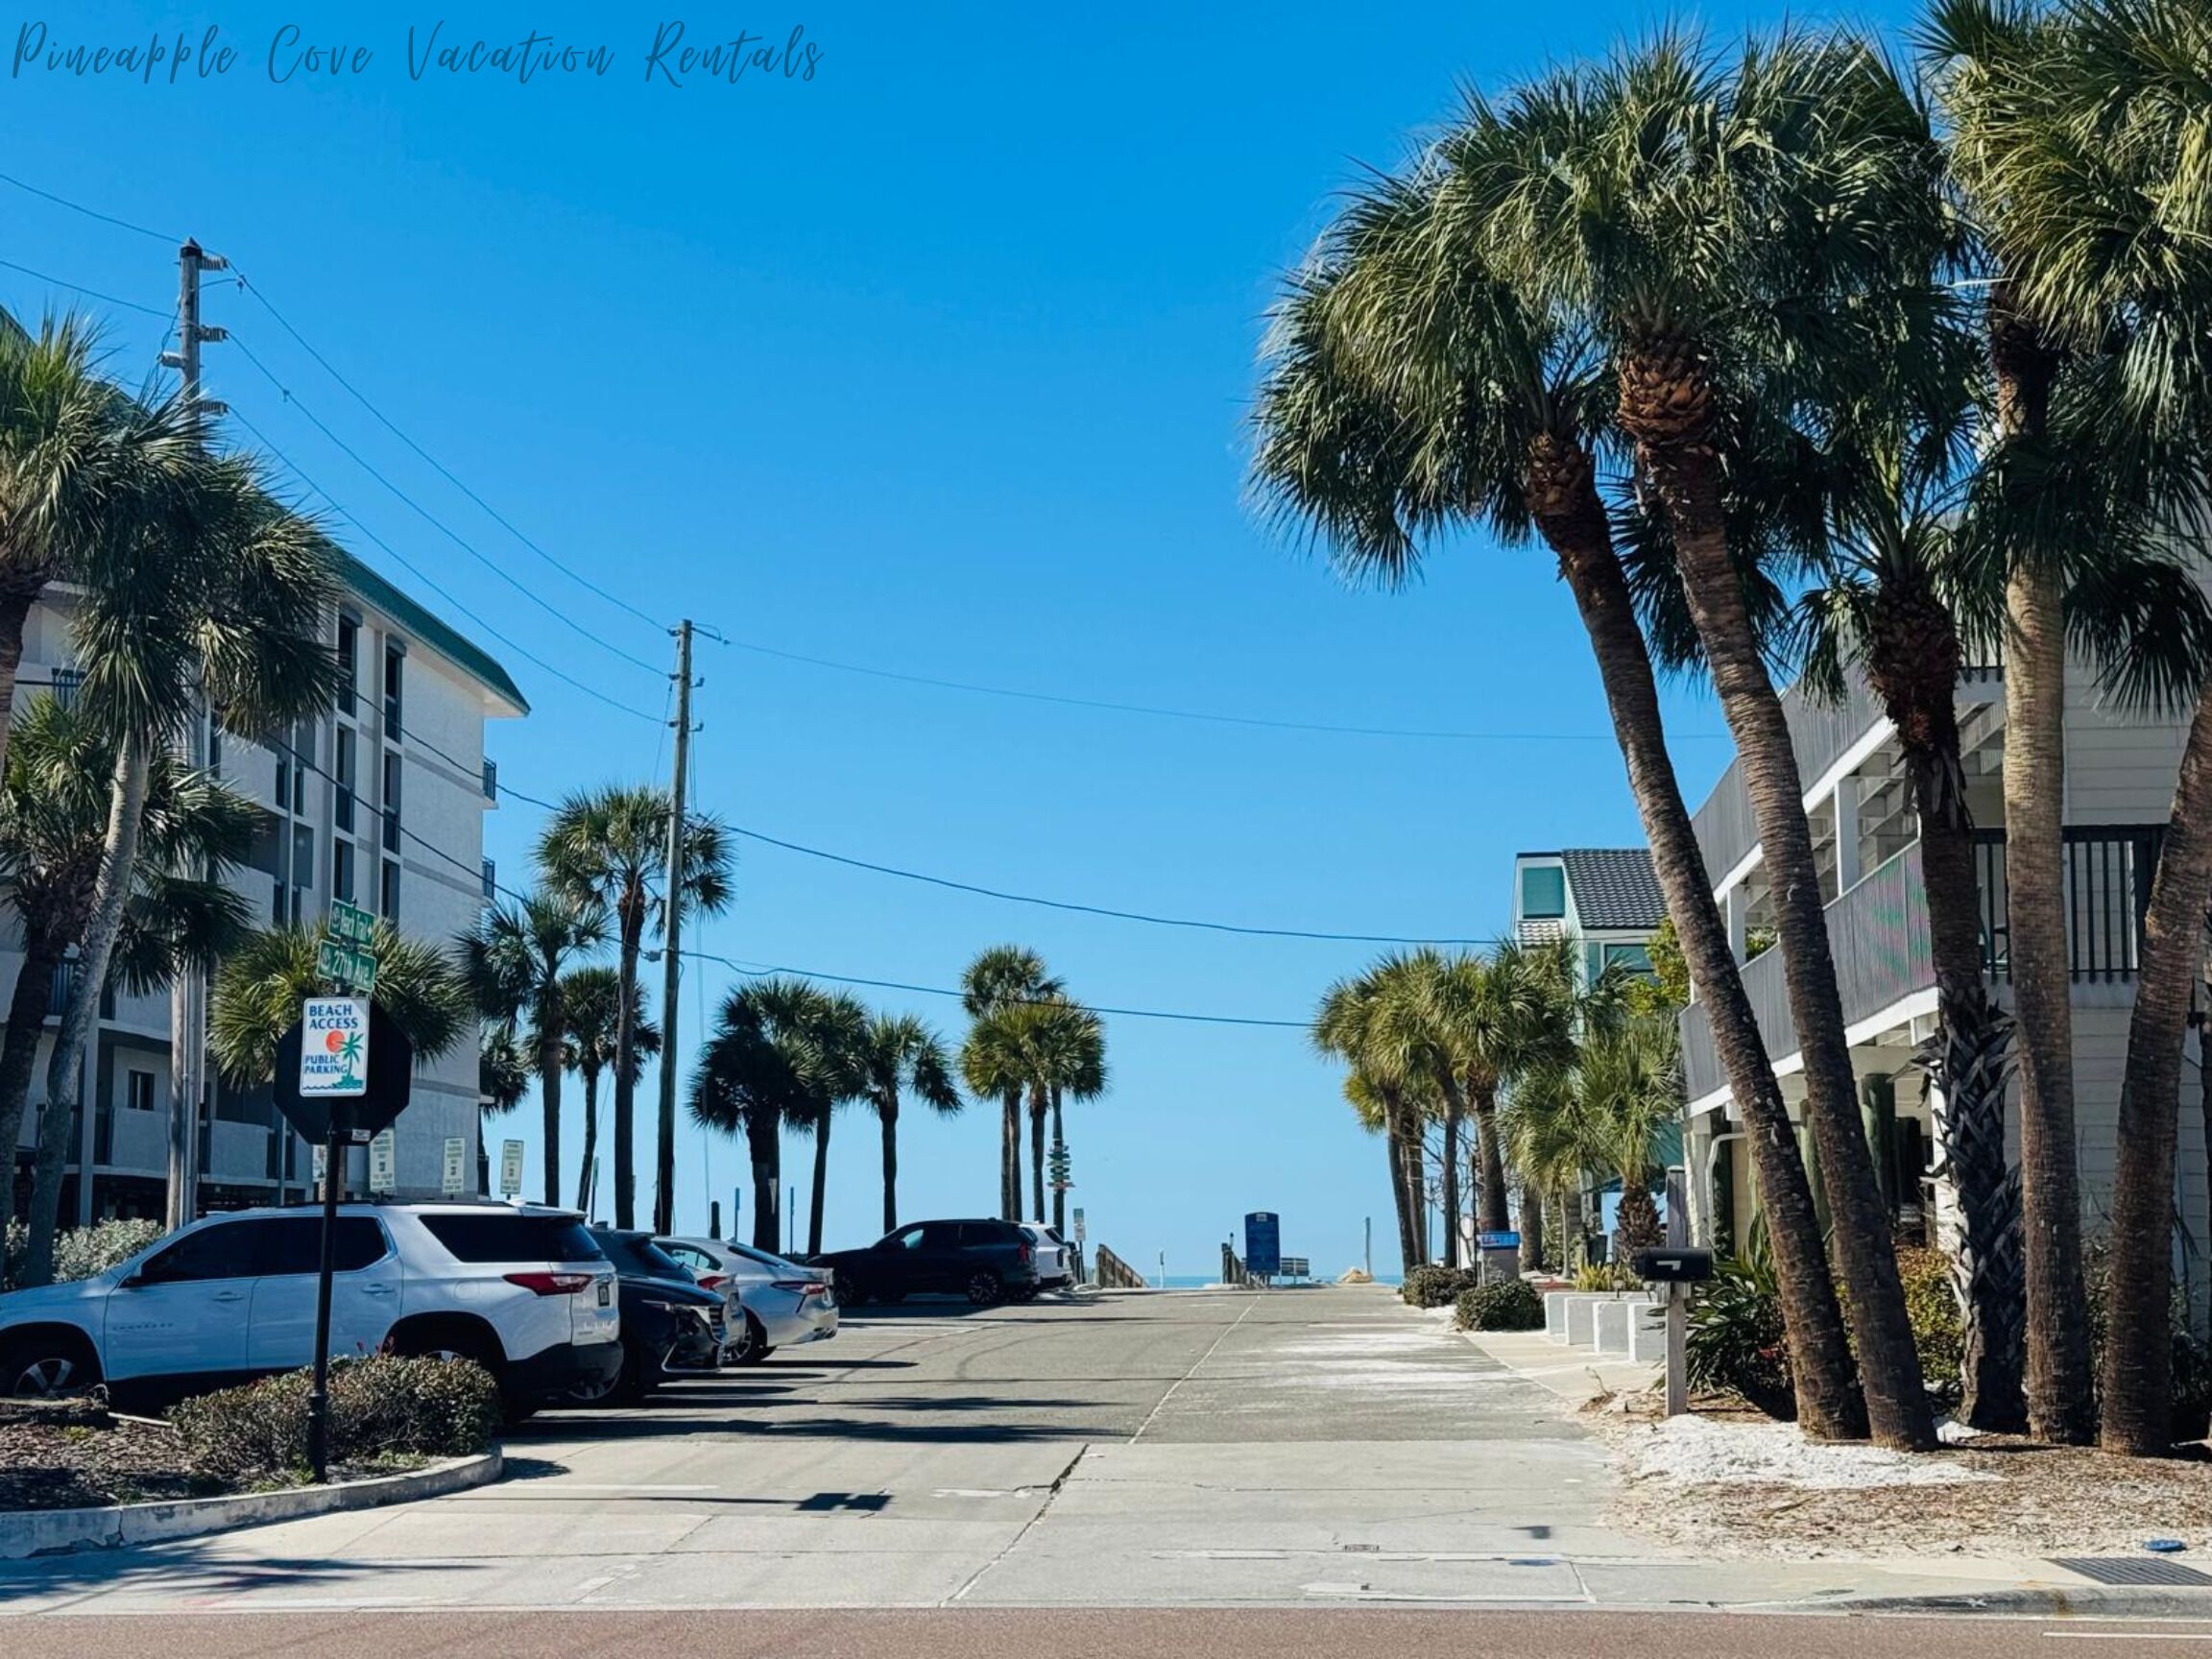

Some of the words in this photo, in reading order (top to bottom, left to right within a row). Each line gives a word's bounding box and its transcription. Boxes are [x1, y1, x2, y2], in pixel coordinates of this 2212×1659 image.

[332, 950, 352, 980] 27th
[308, 1004, 352, 1017] BEACH
[309, 1018, 358, 1029] ACCESS
[304, 1054, 340, 1065] PUBLIC
[303, 1065, 348, 1074] PARKING
